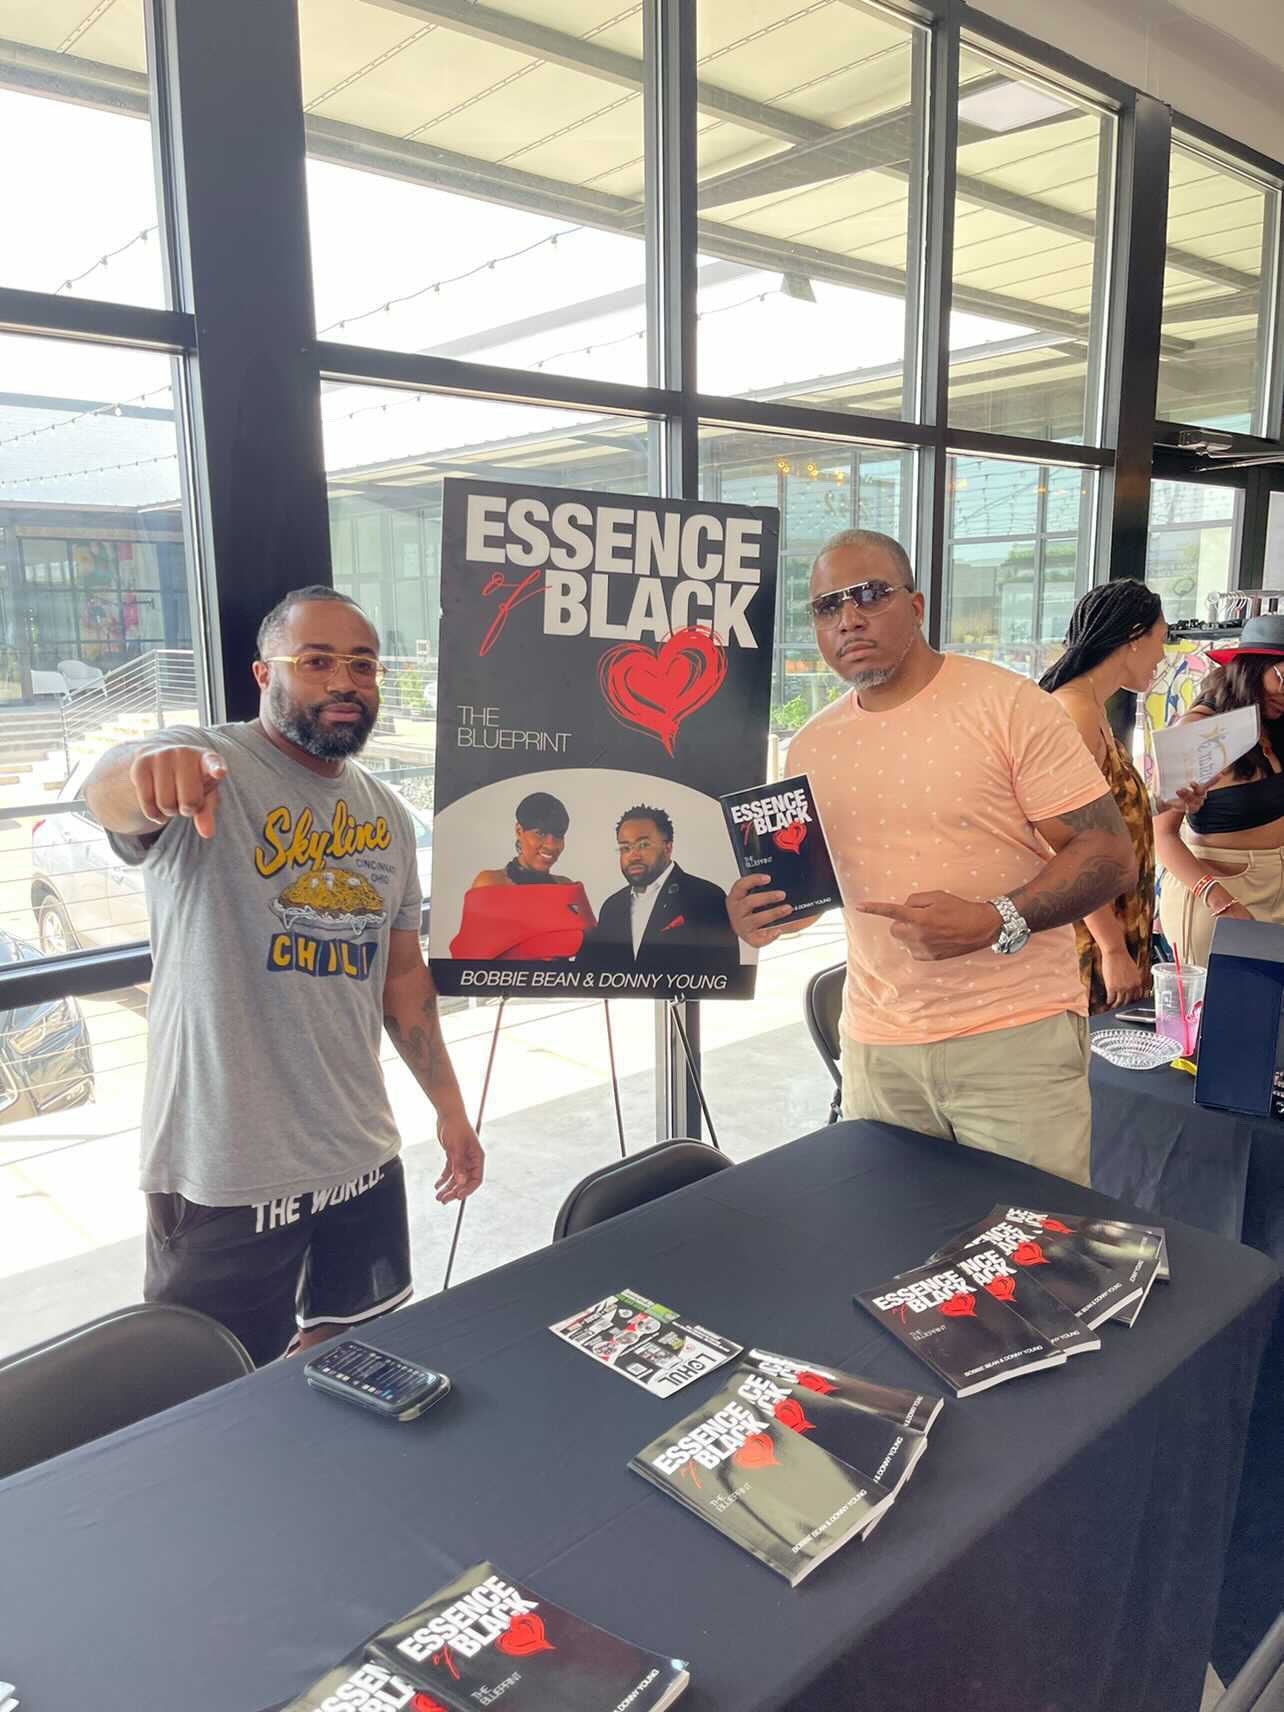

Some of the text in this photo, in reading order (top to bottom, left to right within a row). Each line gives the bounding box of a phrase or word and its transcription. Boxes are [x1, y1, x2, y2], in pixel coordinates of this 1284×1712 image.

[466, 494, 763, 583] ESSENCE
[480, 569, 760, 656] of BLACK
[457, 706, 500, 727] THE
[457, 728, 572, 752] BLUEPRINT
[731, 788, 807, 824] ESSENCE
[753, 801, 812, 835] BLACK
[255, 799, 391, 879] Skyline
[270, 932, 370, 978] CHILI
[460, 970, 729, 990] BOBBIE BEAN & DONNY YOUNG
[252, 1194, 302, 1233] THE
[872, 1269, 963, 1311] ESSENCE
[905, 1277, 978, 1313] BLACK
[652, 1400, 750, 1475] ESSENCE
[692, 1409, 770, 1470] BLACK
[888, 1435, 904, 1457] YOUNG
[396, 1575, 516, 1662] ESSENCE
[447, 1590, 539, 1658] BLACK
[480, 1671, 523, 1706] BLUEPRINT
[617, 1668, 660, 1711] DONNY YOUNG
